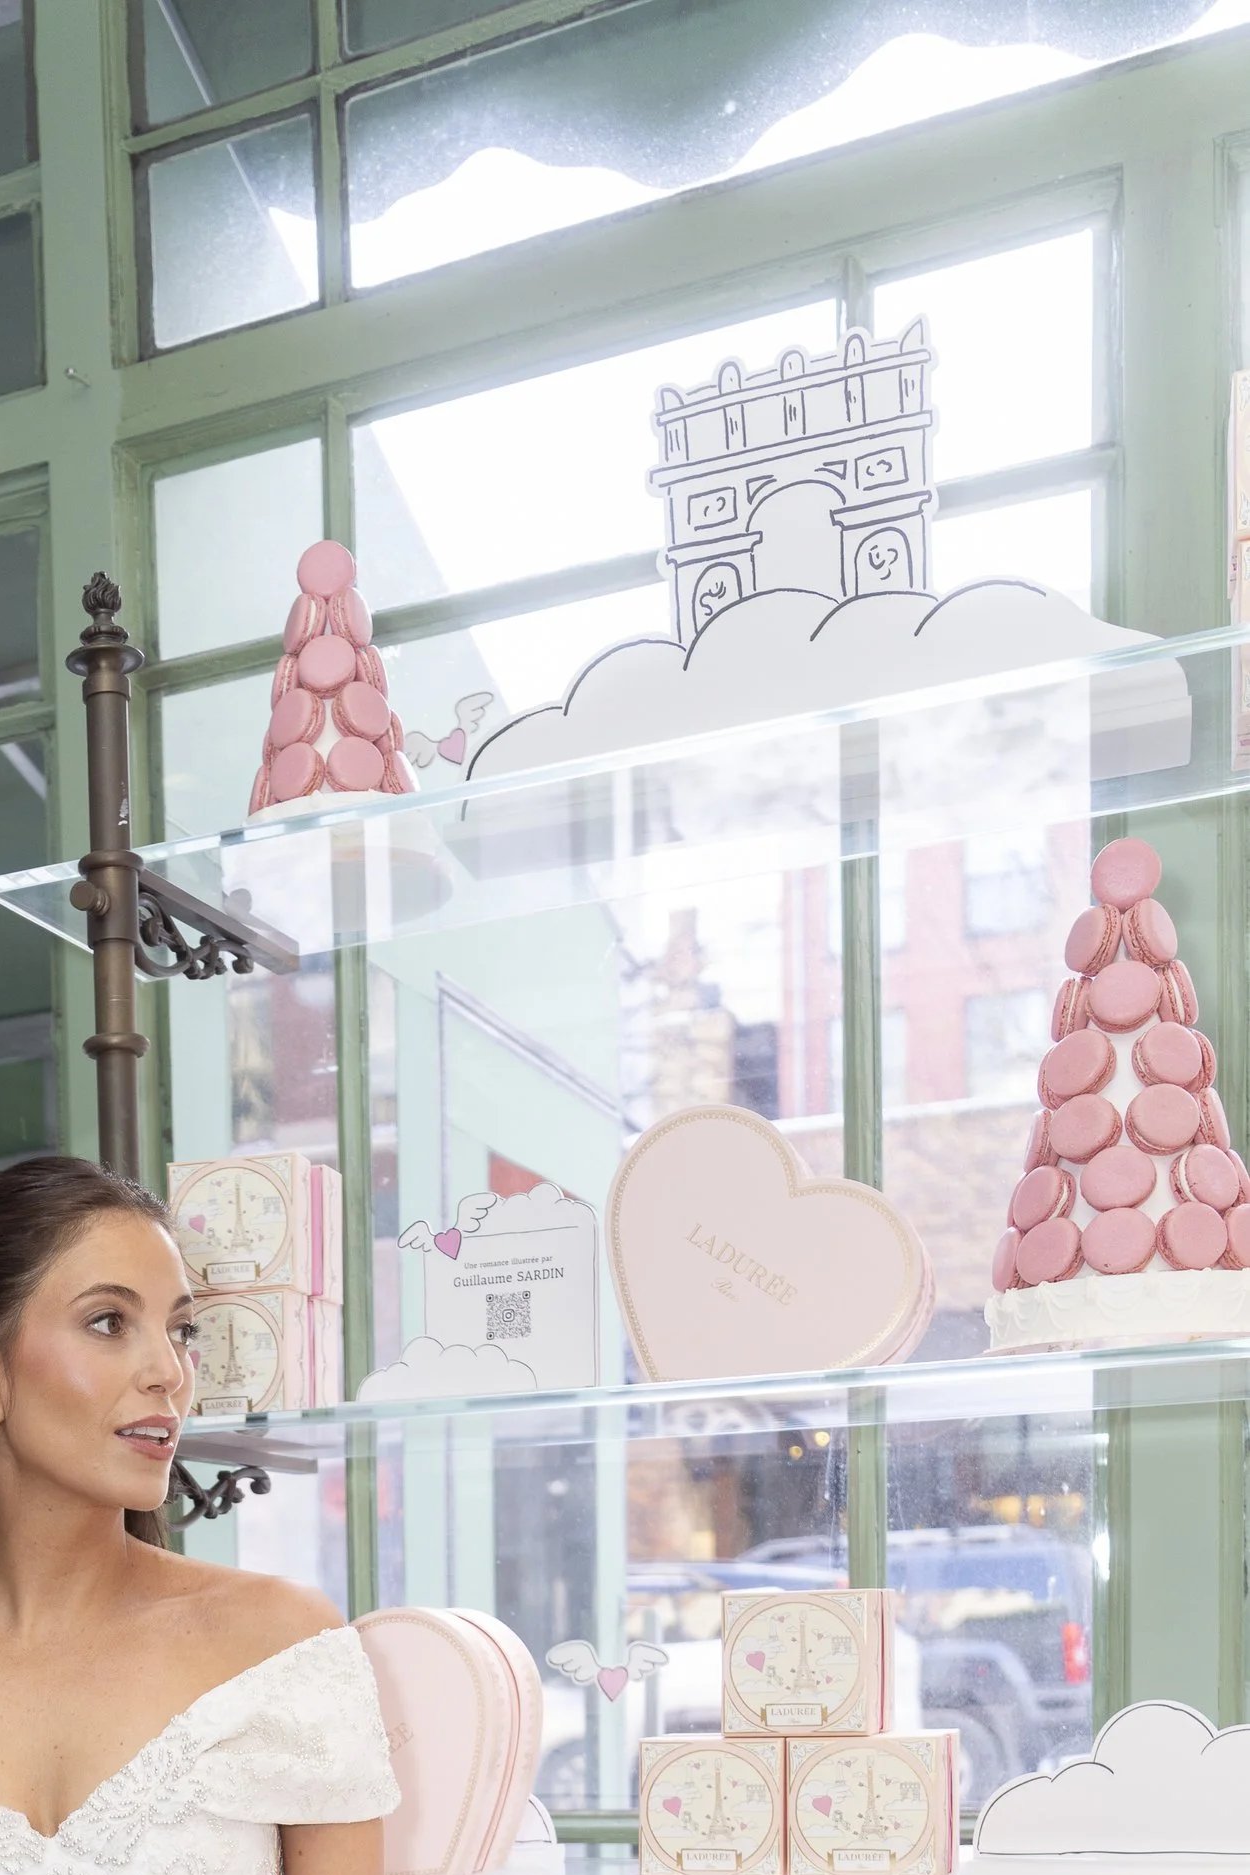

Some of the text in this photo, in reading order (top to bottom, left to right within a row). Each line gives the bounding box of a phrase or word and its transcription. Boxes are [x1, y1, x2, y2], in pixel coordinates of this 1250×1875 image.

[479, 1259, 510, 1268] romance
[541, 1255, 553, 1264] par
[453, 1267, 565, 1288] Guillaume SARDIN
